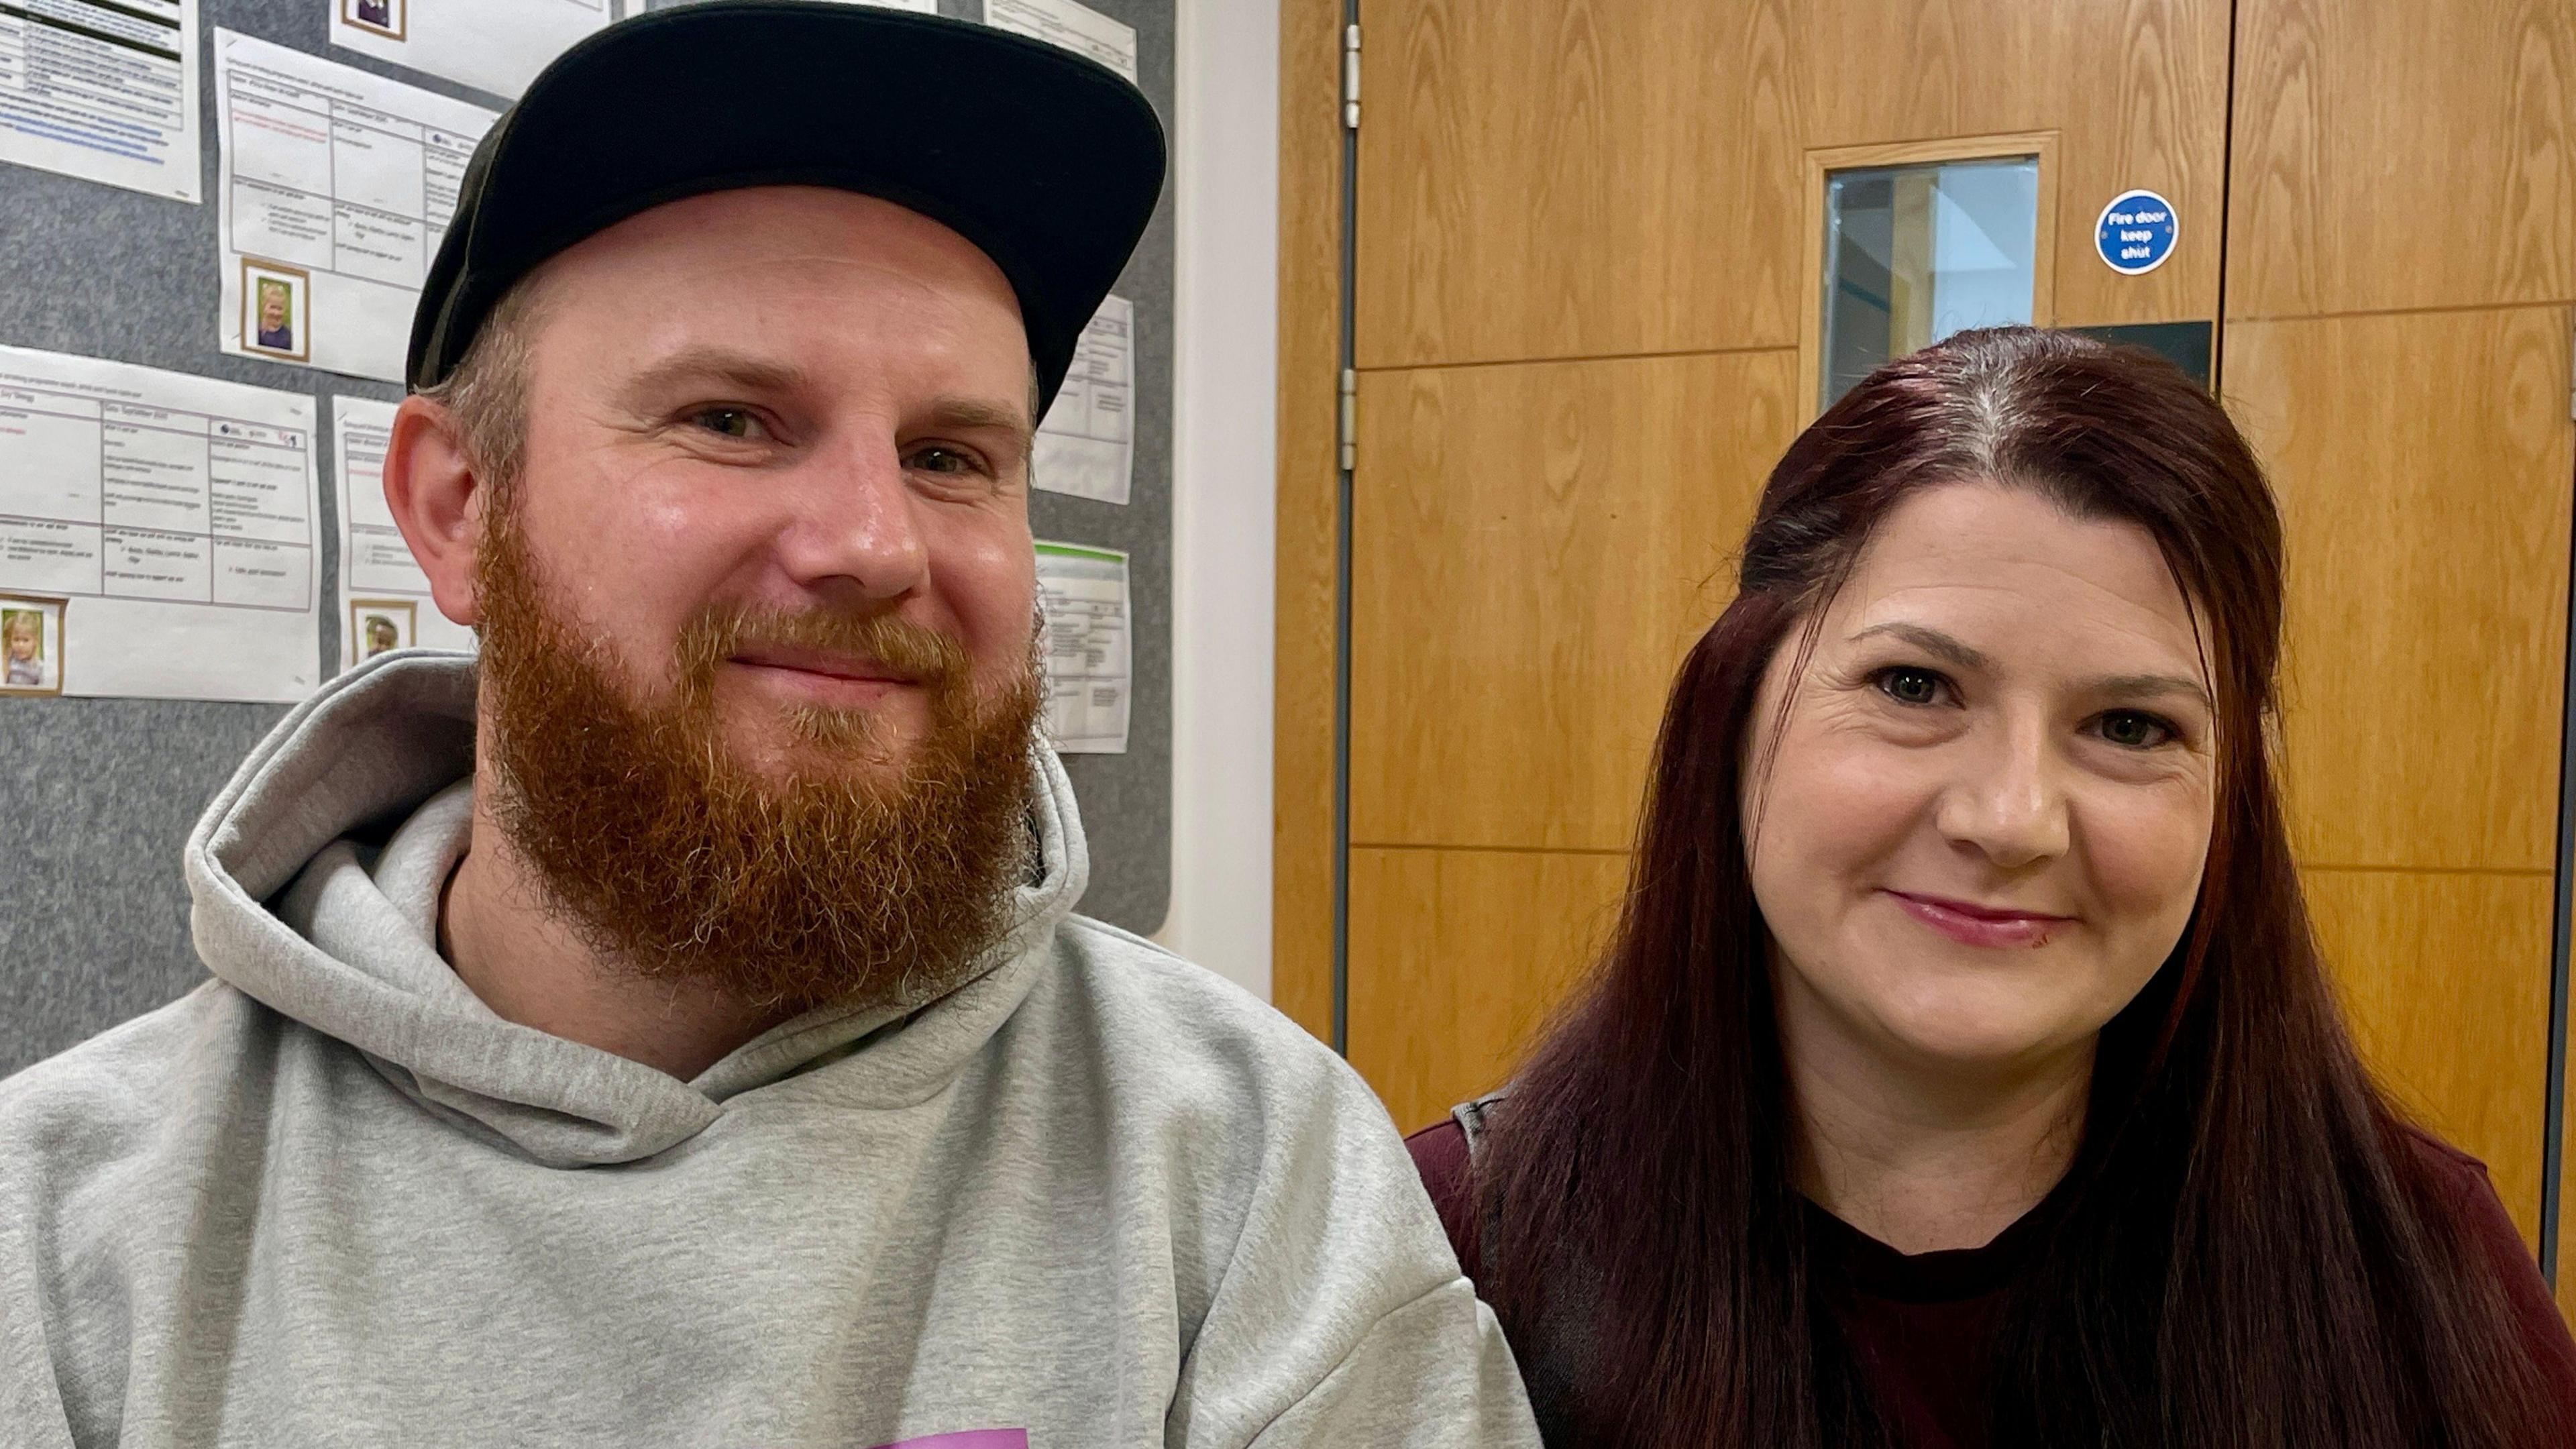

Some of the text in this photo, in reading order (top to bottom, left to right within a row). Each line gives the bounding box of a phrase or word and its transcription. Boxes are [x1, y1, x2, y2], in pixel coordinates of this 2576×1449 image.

[2108, 211, 2167, 225] Fire door
[2121, 229, 2153, 244] keep
[2121, 246, 2151, 260] shut
